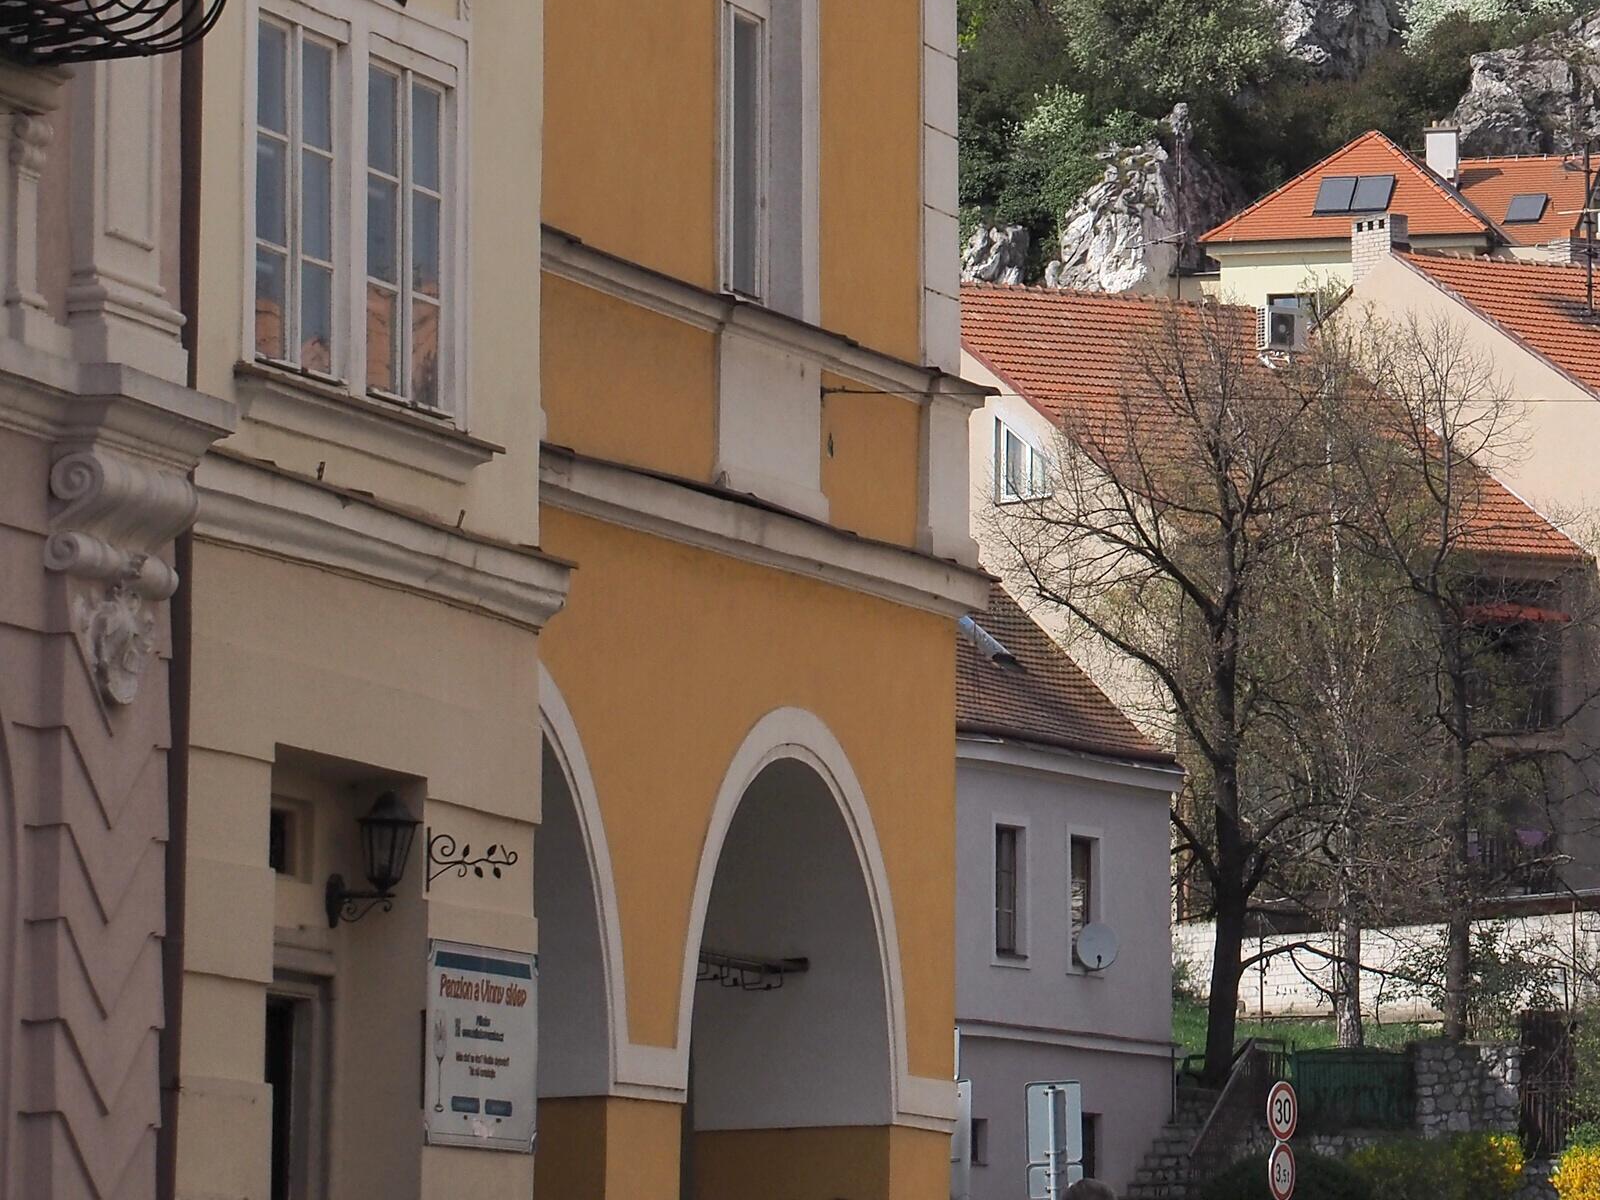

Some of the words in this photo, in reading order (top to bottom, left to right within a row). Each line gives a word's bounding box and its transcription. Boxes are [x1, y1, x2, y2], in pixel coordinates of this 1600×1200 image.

[440, 973, 473, 1000] Penzion
[474, 981, 480, 1001] a
[1275, 1098, 1291, 1125] 30
